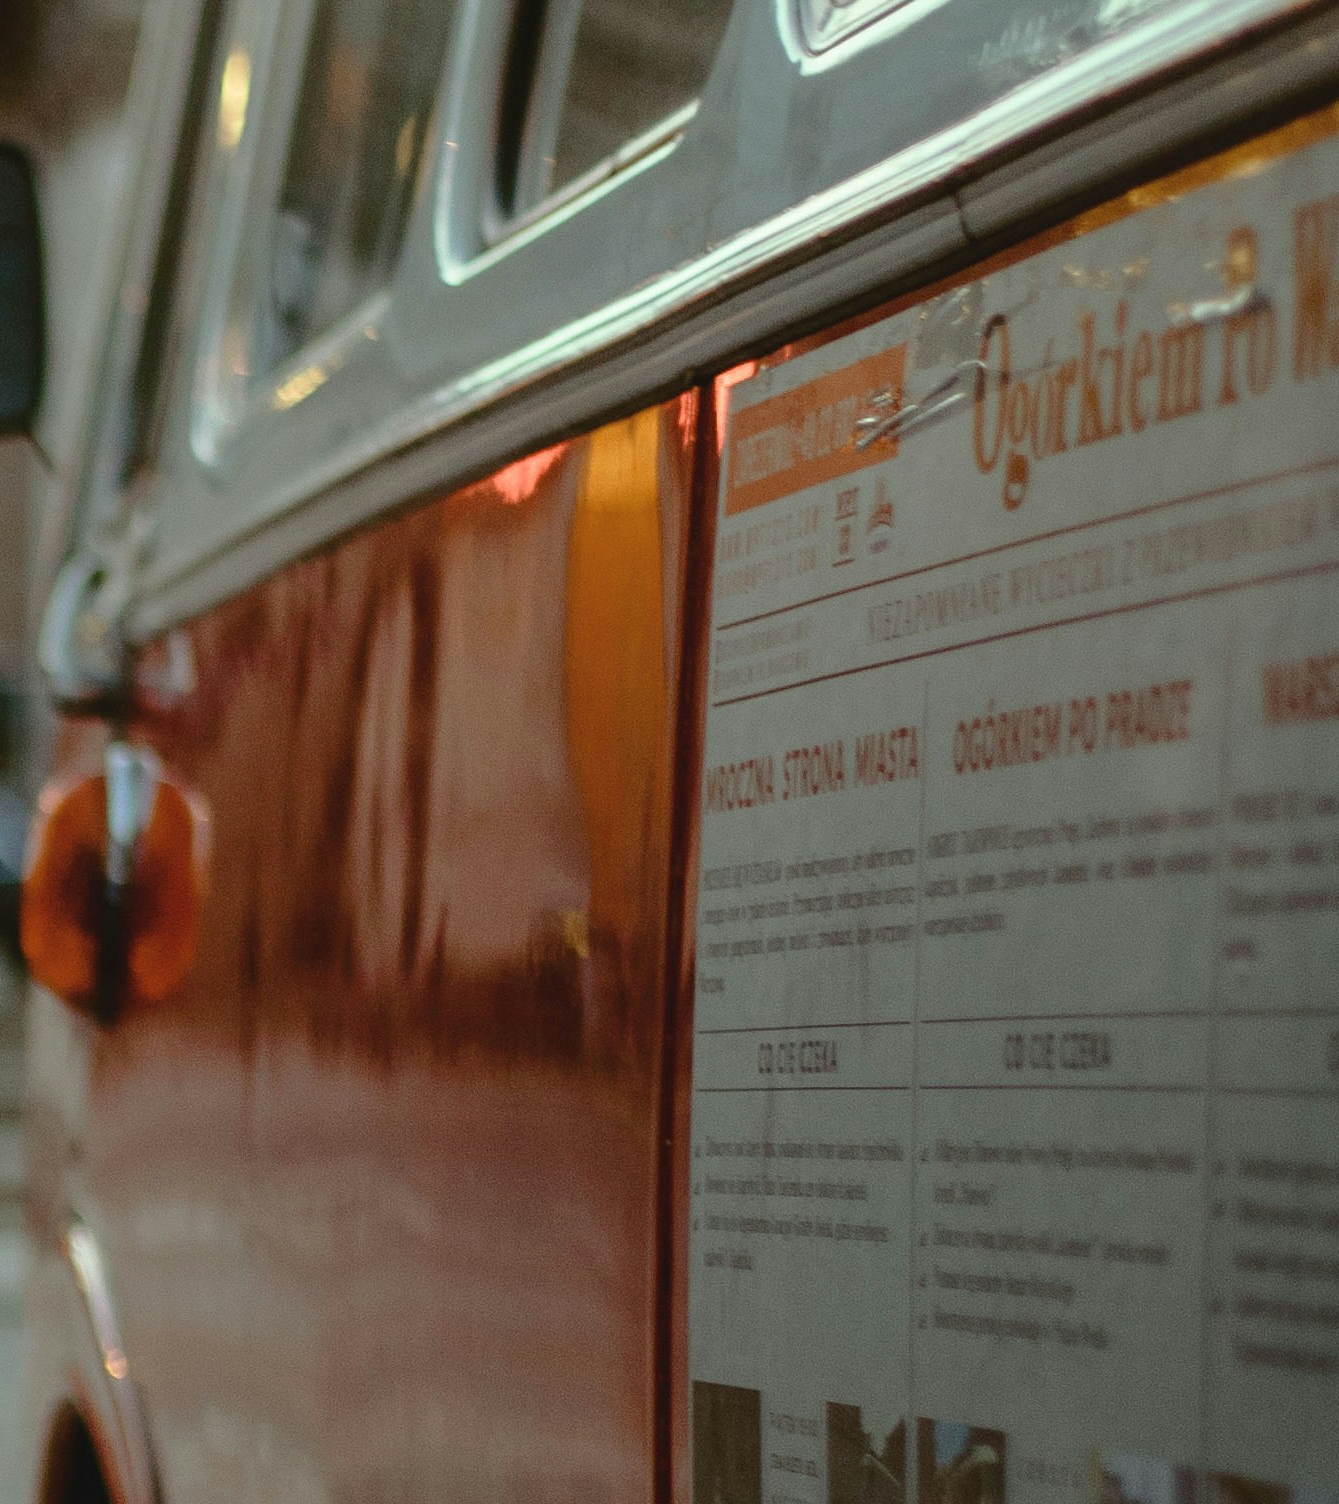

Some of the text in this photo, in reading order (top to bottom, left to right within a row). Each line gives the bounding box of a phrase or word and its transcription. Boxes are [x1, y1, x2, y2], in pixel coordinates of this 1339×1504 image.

[782, 739, 845, 801] STRONA
[854, 725, 920, 786] MIASTA
[953, 678, 1194, 775] OGÓRKIEM PO PRADZE
